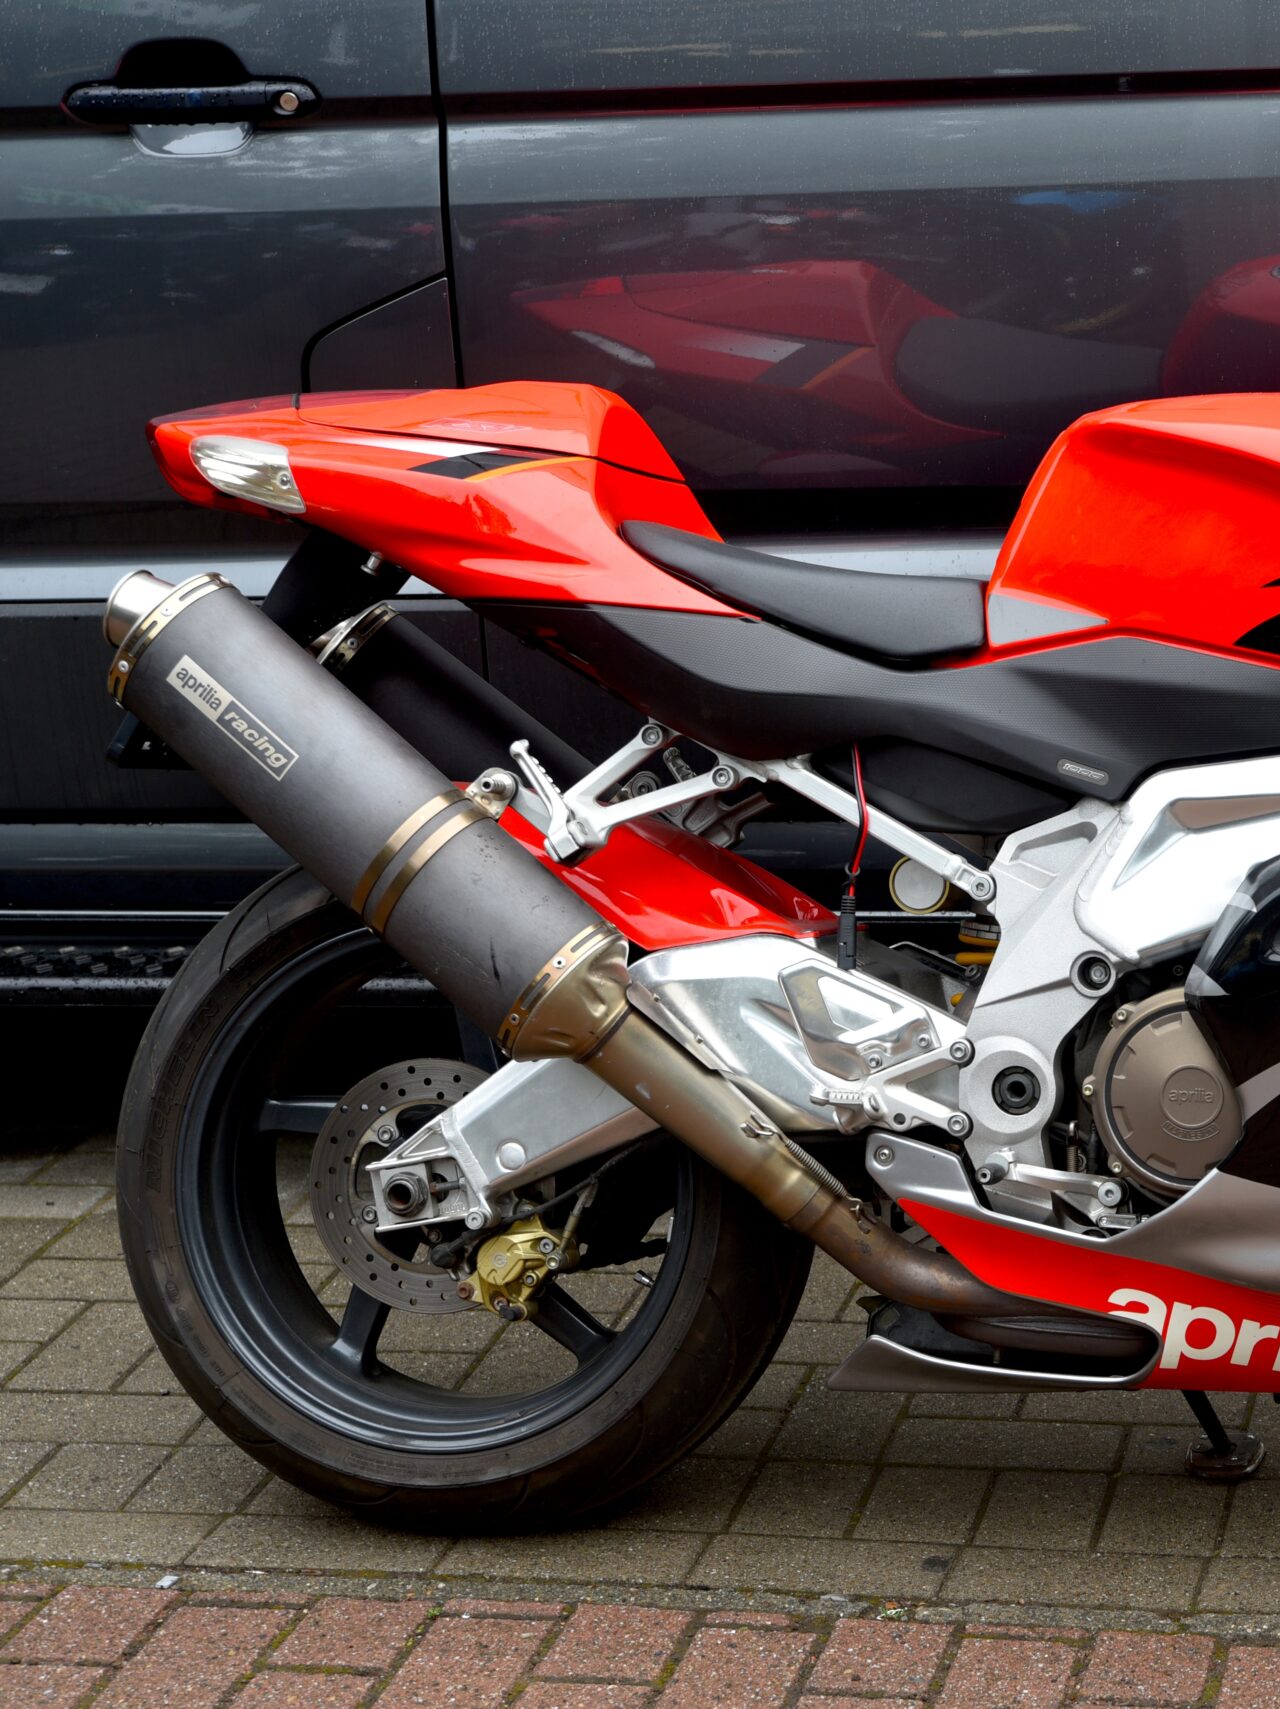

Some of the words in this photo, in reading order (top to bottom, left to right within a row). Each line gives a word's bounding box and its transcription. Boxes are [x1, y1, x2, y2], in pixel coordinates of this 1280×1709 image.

[176, 667, 223, 712] aprilia
[224, 711, 288, 768] racing
[1168, 1088, 1214, 1106] aprilia
